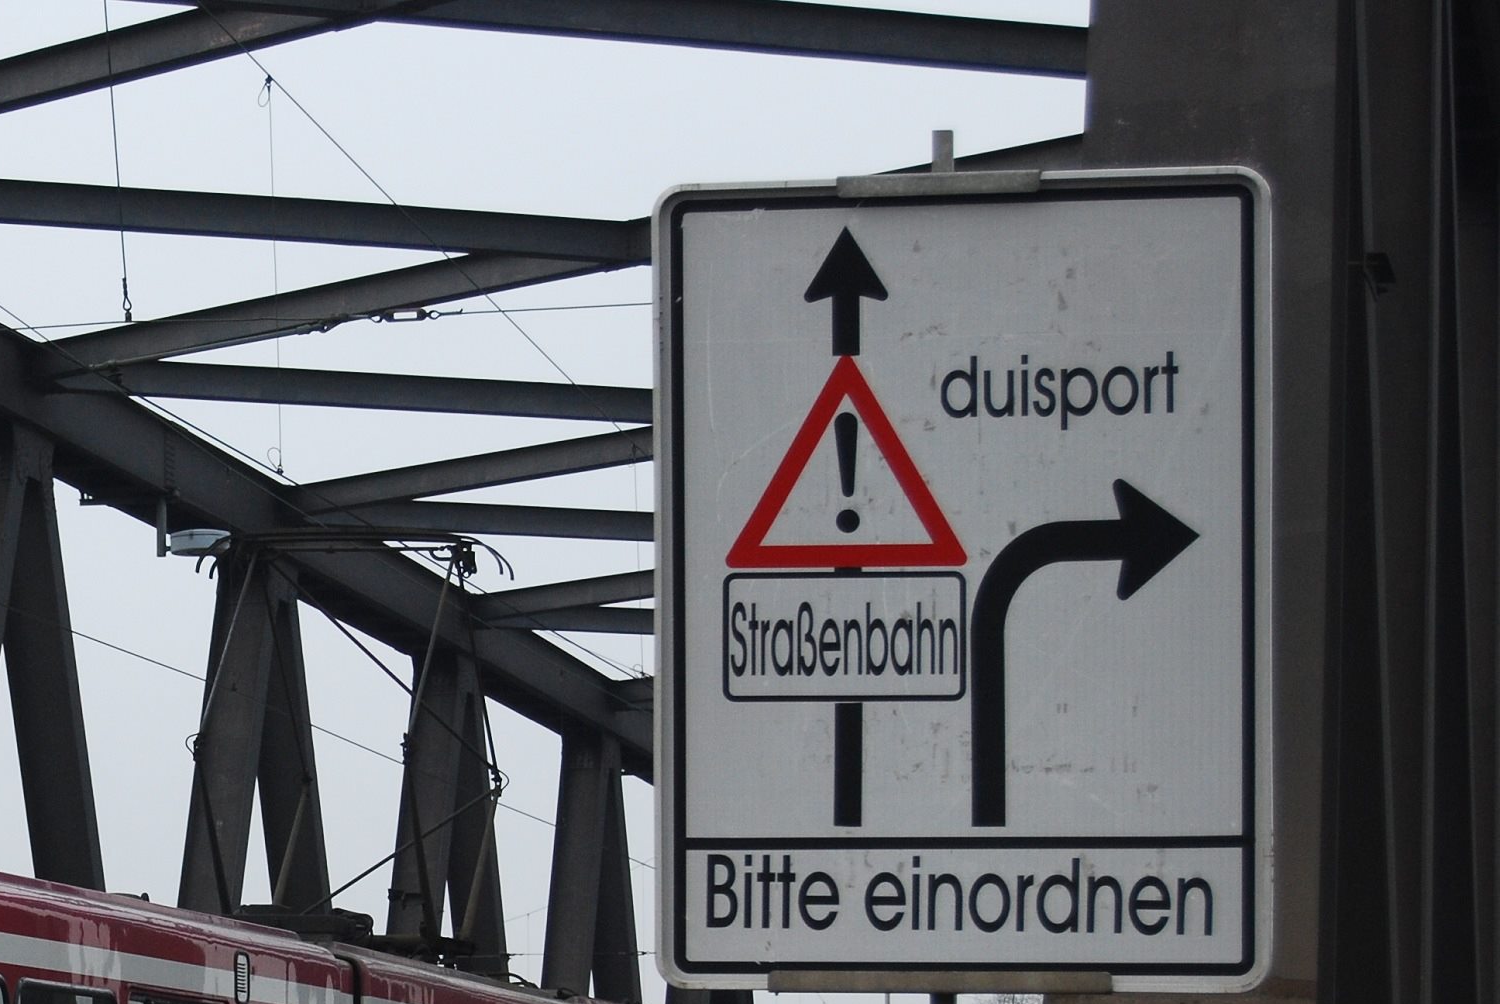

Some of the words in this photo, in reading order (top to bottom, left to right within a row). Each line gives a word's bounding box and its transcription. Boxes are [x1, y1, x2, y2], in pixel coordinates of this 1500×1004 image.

[940, 351, 1180, 430] duisport
[729, 600, 959, 678] Straßenbahn
[705, 853, 840, 930] Bitte
[864, 856, 1214, 937] einordnen
